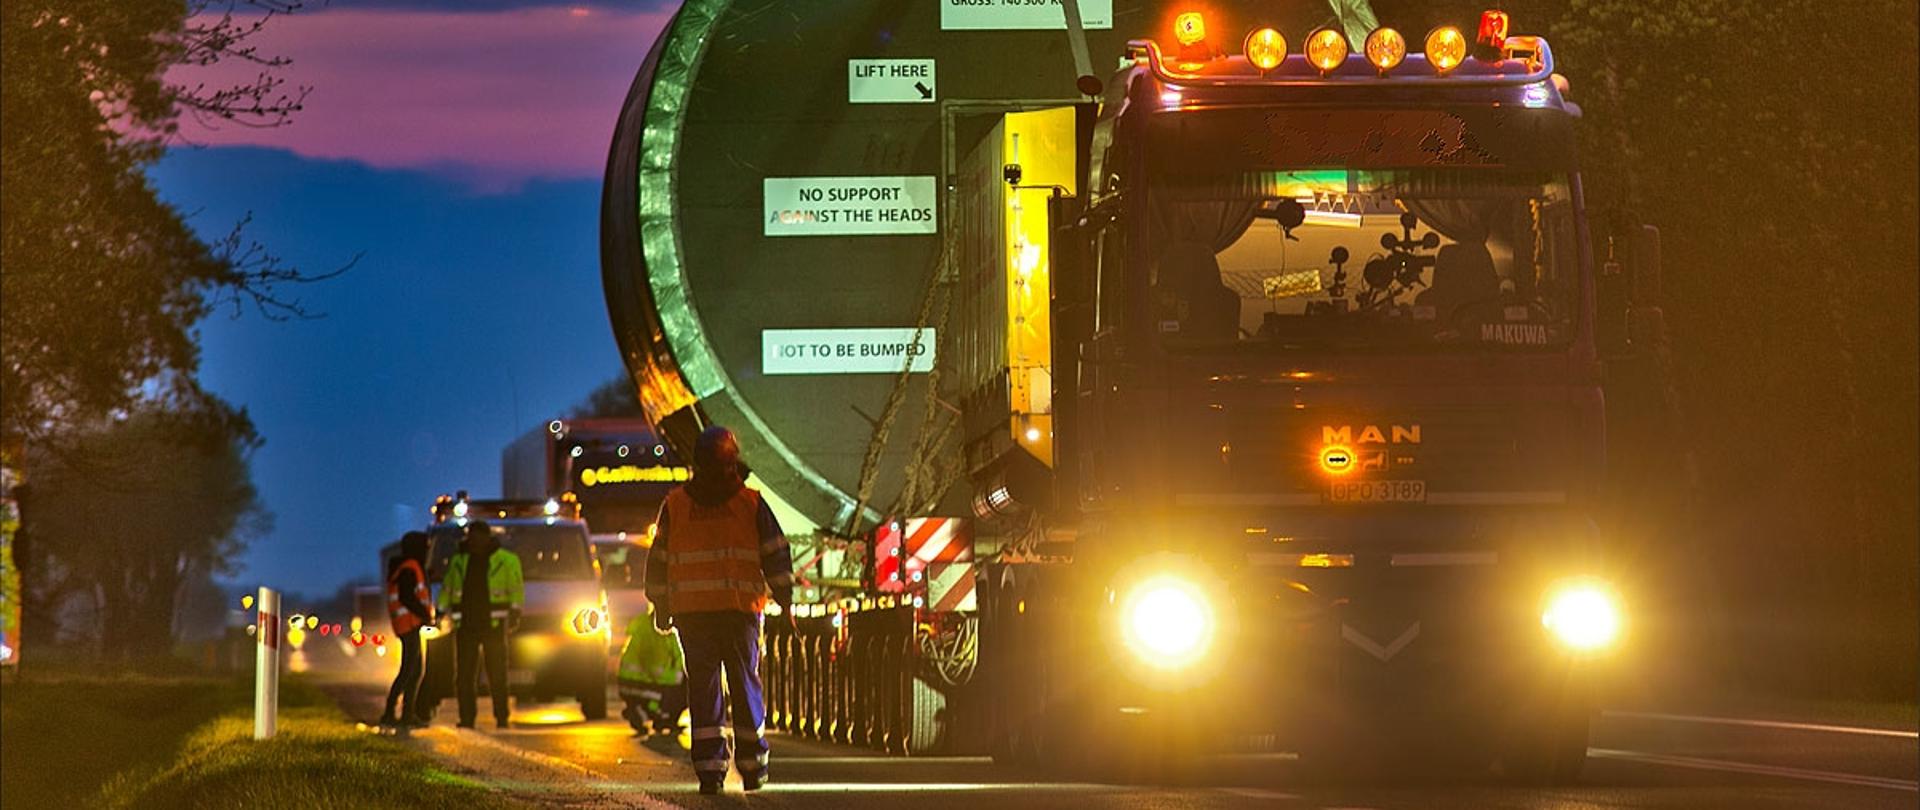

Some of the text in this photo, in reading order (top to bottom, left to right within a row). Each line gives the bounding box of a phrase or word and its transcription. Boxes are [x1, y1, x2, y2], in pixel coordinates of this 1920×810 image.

[856, 65, 928, 77] LIFT HERE
[800, 187, 901, 201] NO SUPPORT
[770, 208, 932, 224] AGAINST THE HEADS
[1481, 324, 1547, 345] MAKUWA
[811, 344, 831, 358] TO
[836, 343, 855, 357] BE
[860, 343, 925, 357] BUMPED
[1323, 425, 1420, 443] MAN
